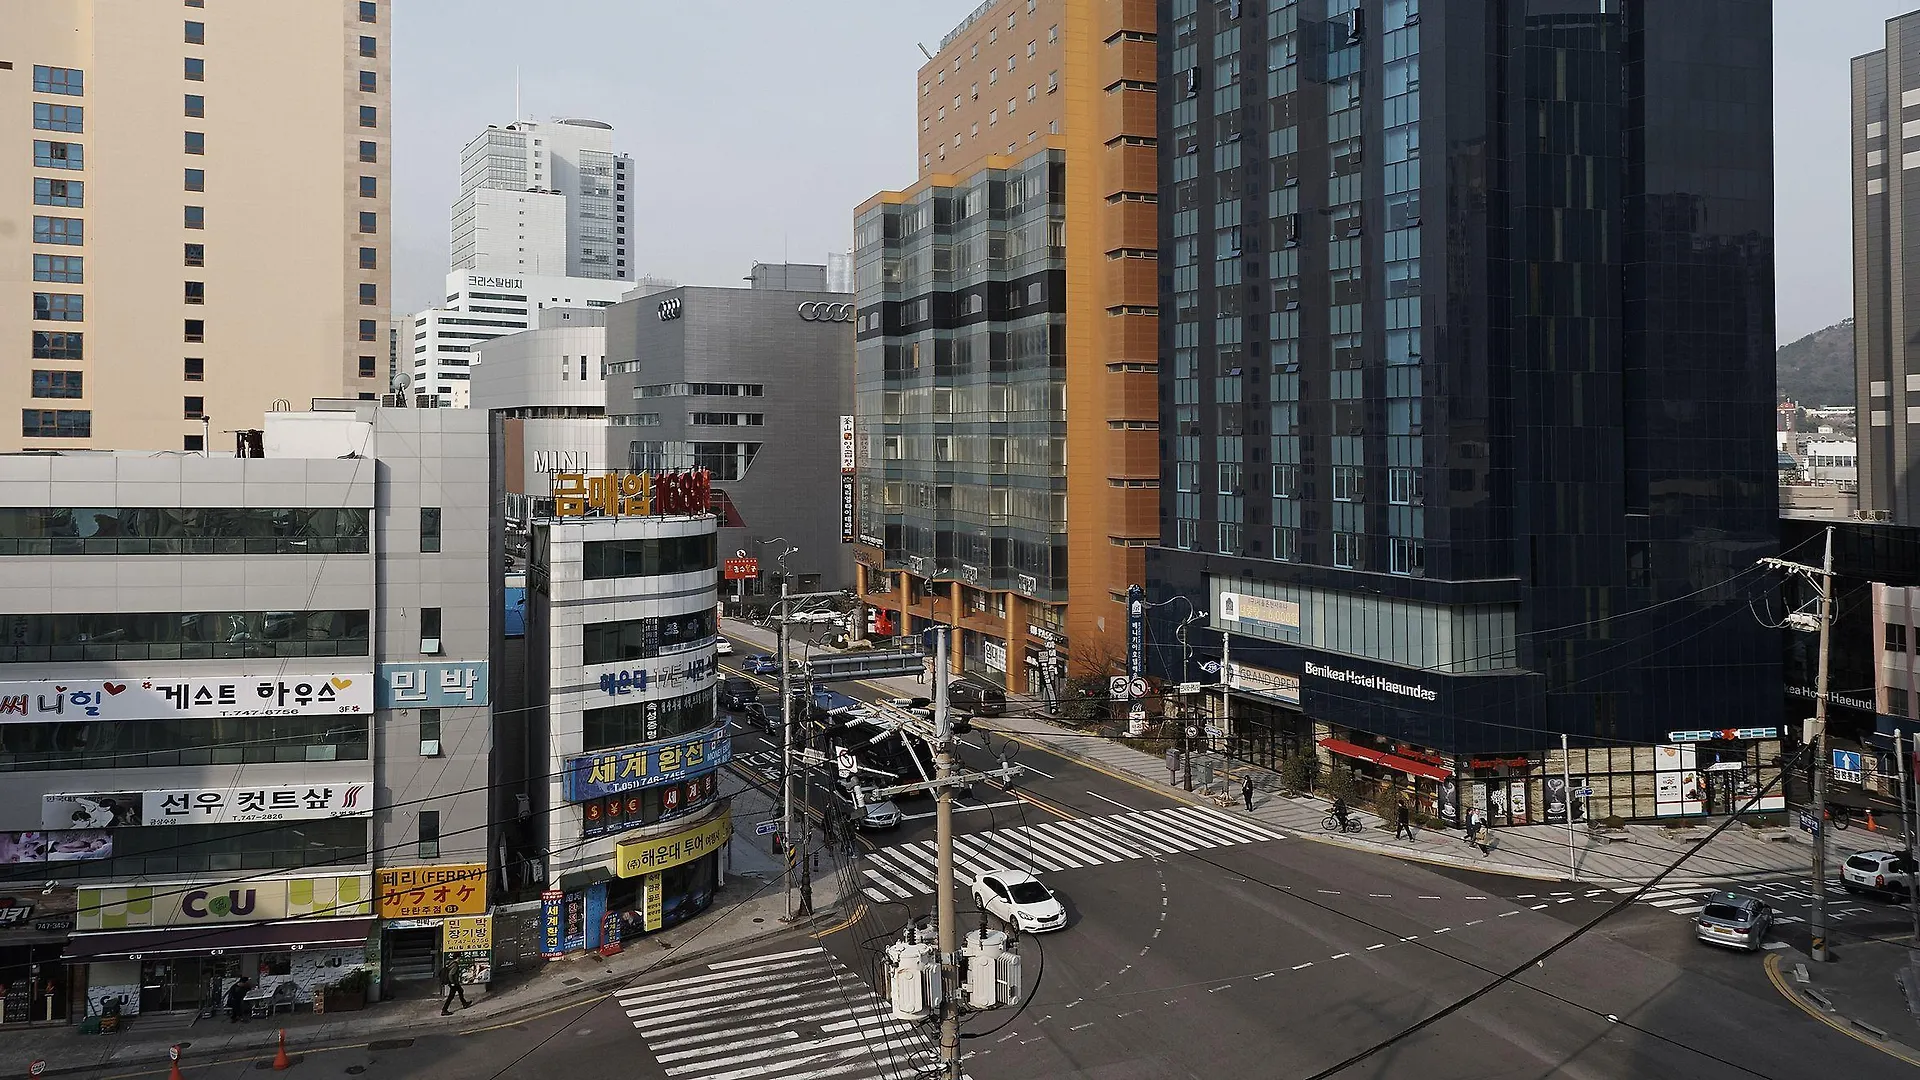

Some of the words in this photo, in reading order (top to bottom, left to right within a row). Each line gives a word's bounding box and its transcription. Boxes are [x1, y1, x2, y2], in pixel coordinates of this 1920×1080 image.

[468, 275, 523, 289] 크리스탈비치
[533, 450, 590, 474] MINI
[554, 472, 650, 517] 금매입
[391, 668, 479, 702] 민박
[600, 669, 647, 696] 해운대
[1240, 667, 1272, 686] GRAND
[1273, 675, 1299, 693] OPEN
[1305, 661, 1345, 683] Benikea
[1346, 670, 1375, 689] Hotel
[1376, 677, 1437, 701] Haeundae
[156, 683, 236, 710] 게스트
[256, 681, 336, 707] 하우스
[338, 706, 351, 714] 3F
[588, 749, 648, 784] 세계
[658, 738, 705, 773] 환전
[160, 792, 225, 816] 선우
[237, 787, 333, 812] 컷트샵
[591, 804, 598, 817] $
[610, 802, 618, 814] ¥
[628, 799, 637, 811] €
[232, 813, 284, 822] T.747-2826
[683, 833, 704, 856] 투어
[382, 870, 416, 887] 페리
[421, 868, 483, 884] (FERRY)
[182, 889, 256, 918] CU
[383, 884, 476, 907] カラオケ
[401, 905, 442, 916] 단란주점
[448, 927, 488, 940] 장기방
